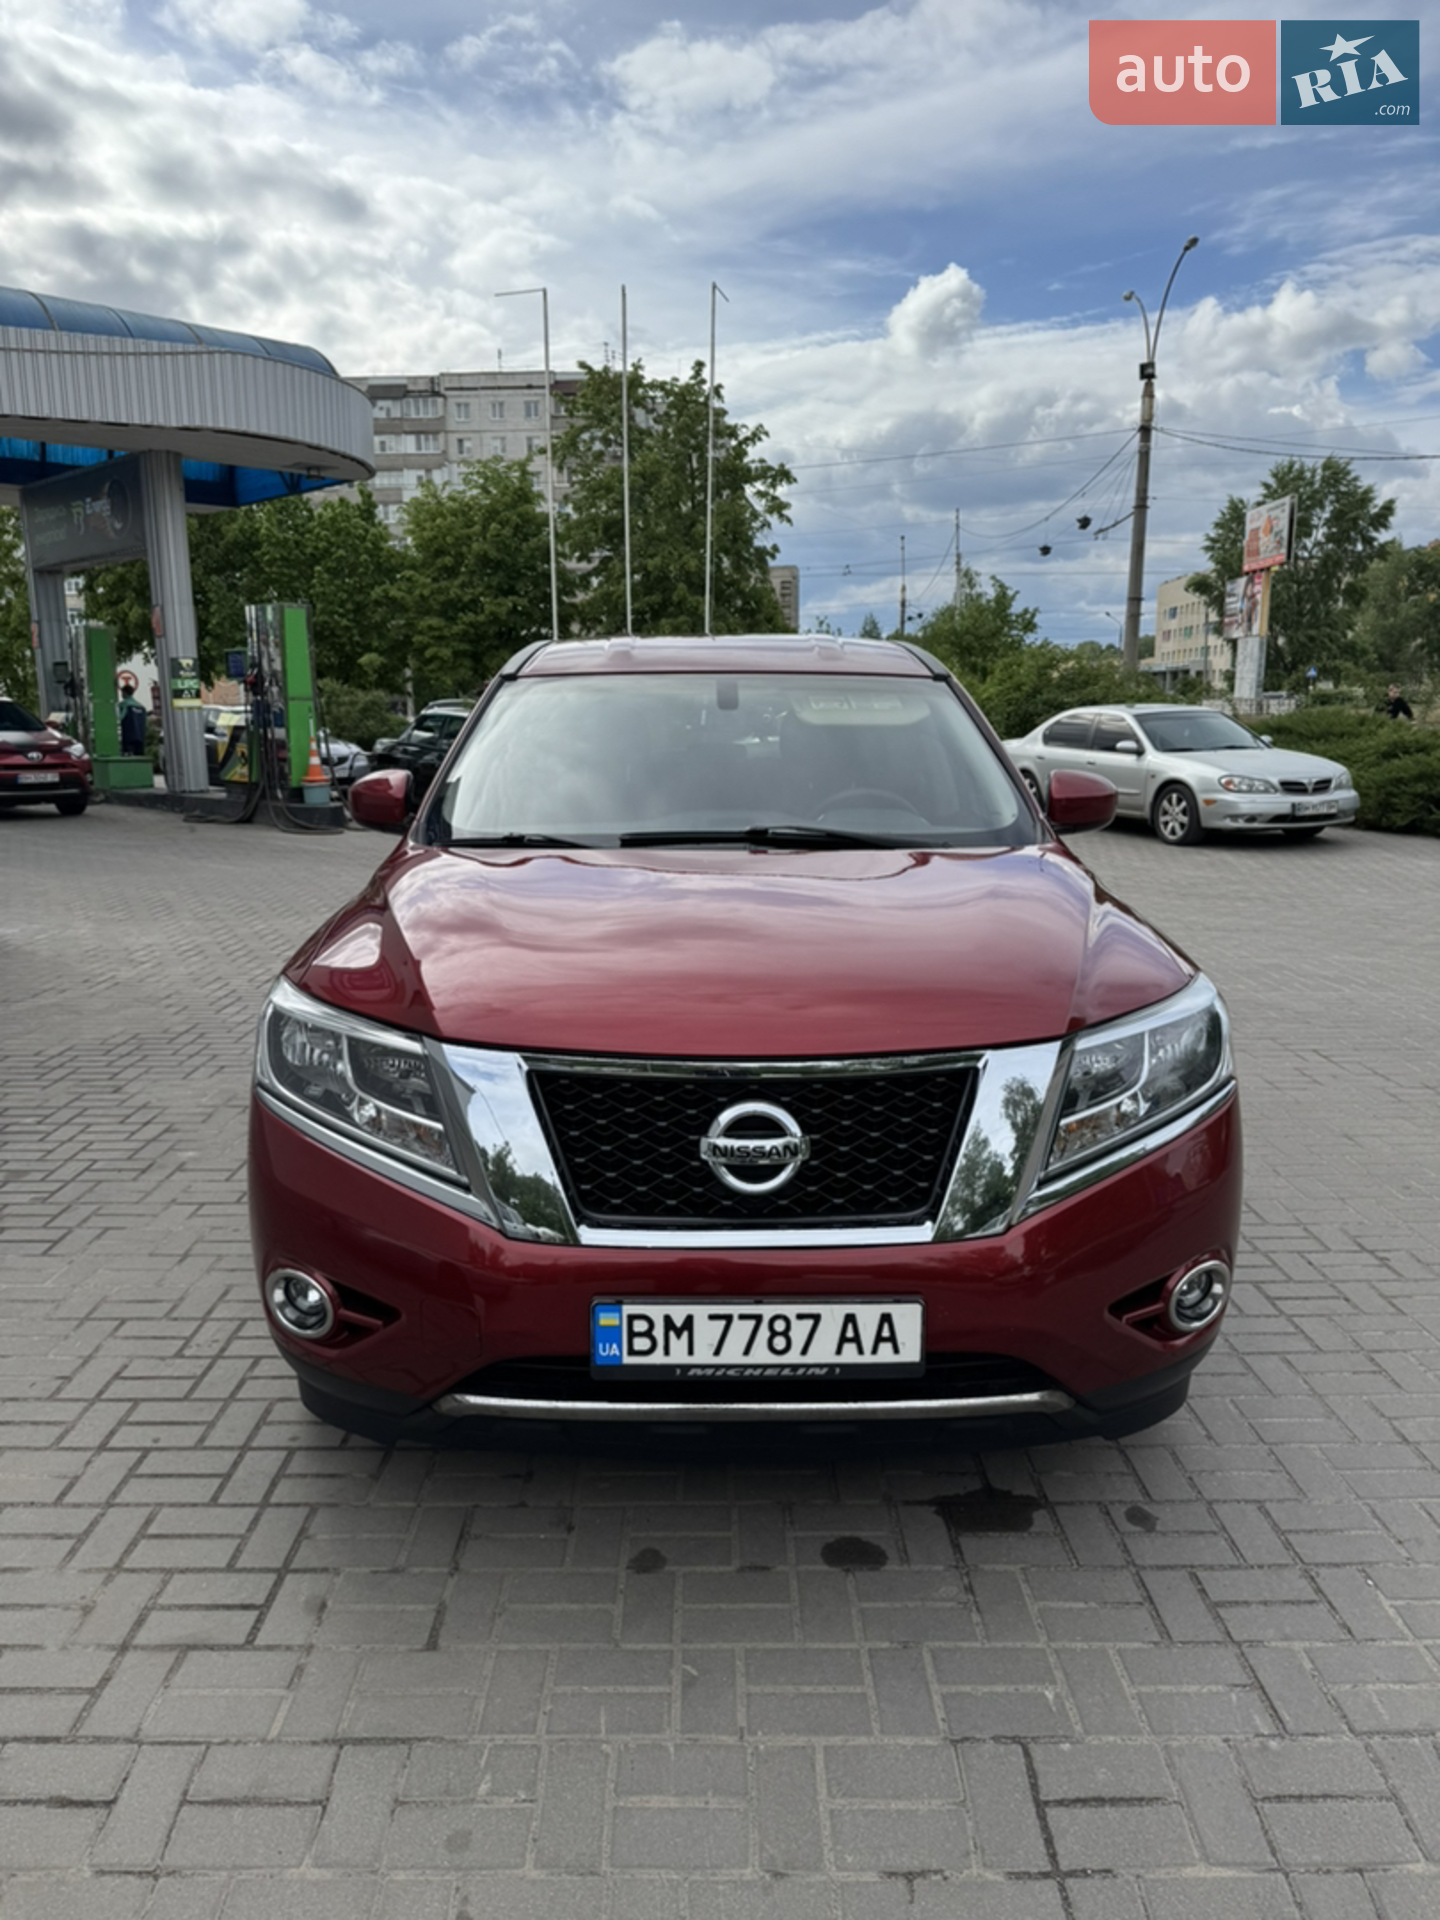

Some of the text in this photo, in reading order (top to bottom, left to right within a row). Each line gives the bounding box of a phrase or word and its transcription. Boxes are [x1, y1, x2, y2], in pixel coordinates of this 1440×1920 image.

[711, 1143, 800, 1159] NISSAN
[626, 1312, 901, 1357] BM 7787 AA
[598, 1342, 620, 1357] UA
[687, 1366, 829, 1377] MICHELIN
